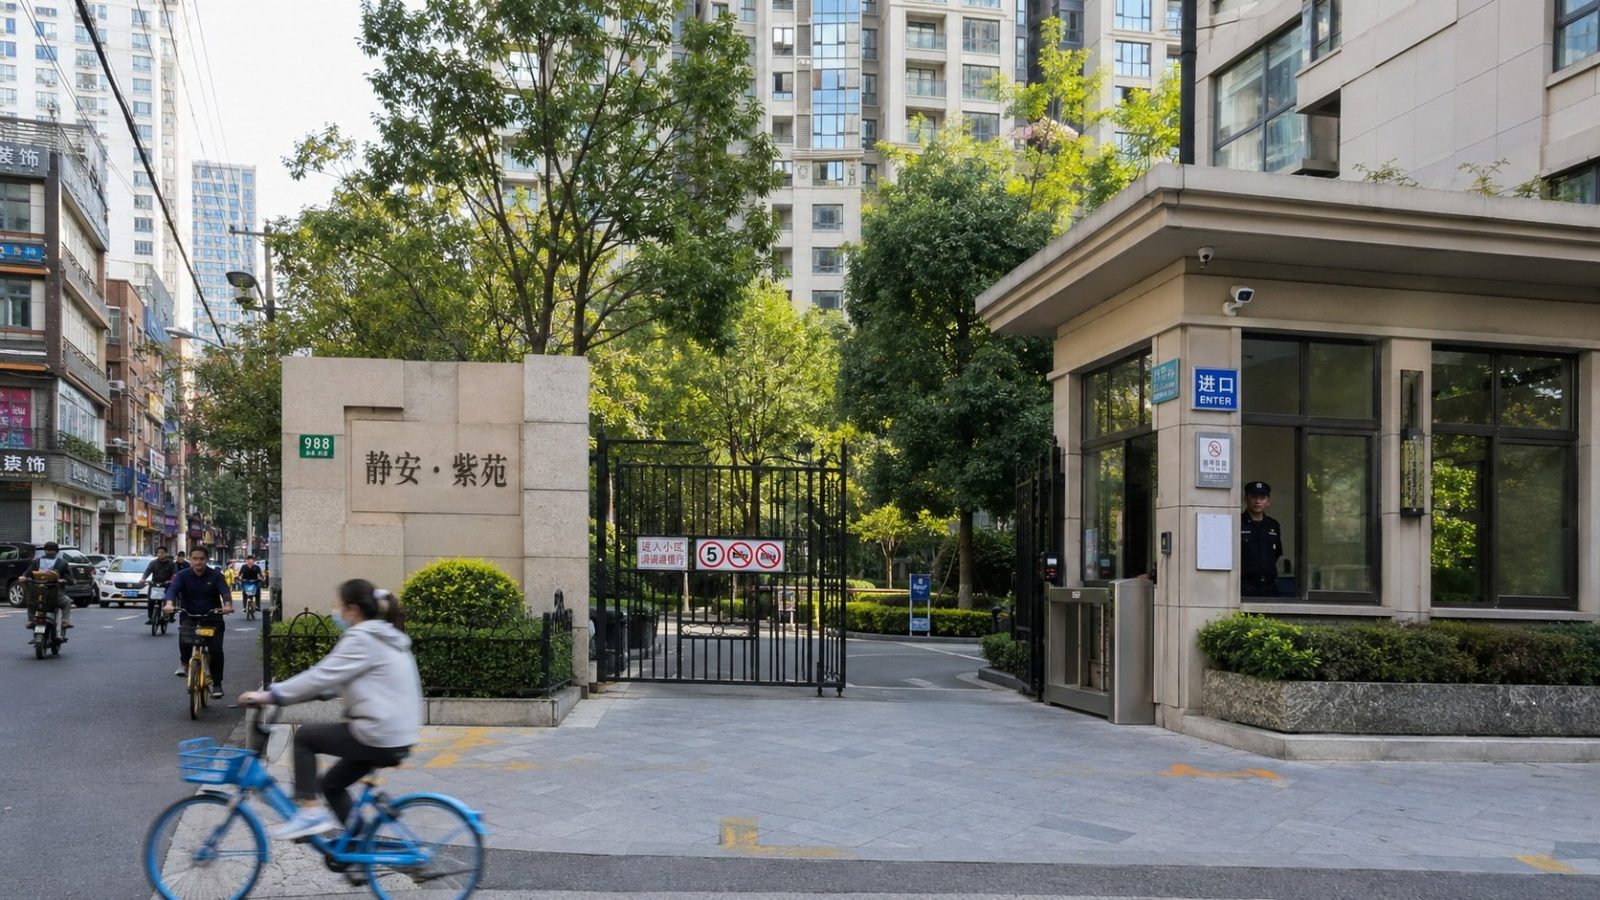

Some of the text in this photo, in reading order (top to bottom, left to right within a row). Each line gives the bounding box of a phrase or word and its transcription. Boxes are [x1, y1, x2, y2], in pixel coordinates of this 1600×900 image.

[1199, 375, 1234, 394] 进口
[1200, 396, 1232, 406] ENTER
[304, 437, 330, 450] 988
[0, 454, 46, 473] 装饰
[707, 547, 717, 562] 5
